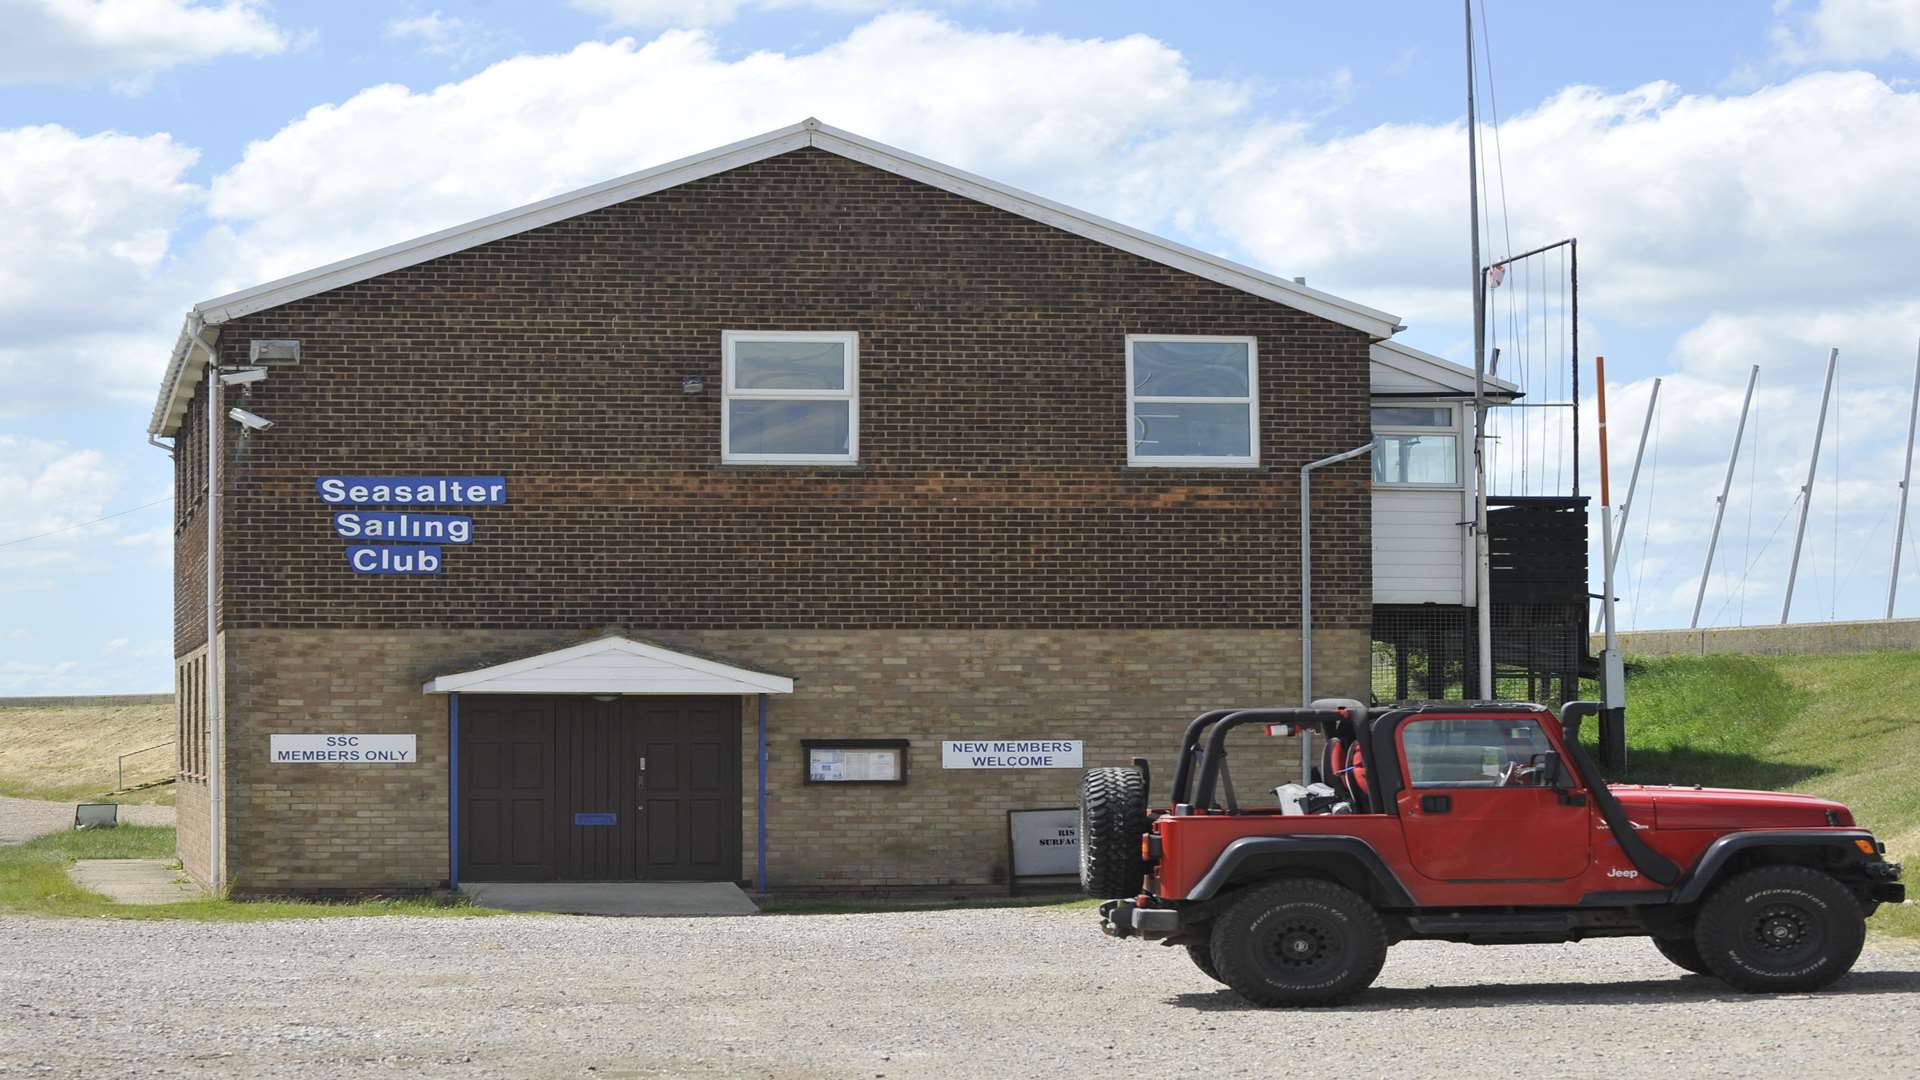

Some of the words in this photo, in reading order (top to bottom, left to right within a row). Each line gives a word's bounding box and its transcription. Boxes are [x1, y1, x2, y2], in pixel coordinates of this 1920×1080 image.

[321, 479, 503, 502] Seasalter
[337, 514, 469, 542] Sailing
[353, 549, 438, 571] Club
[326, 736, 359, 747] SSC
[952, 743, 988, 753] NEW
[993, 742, 1073, 753] MEMBERS
[278, 750, 360, 761] MEMBERS
[365, 750, 408, 761] ONLY
[972, 756, 1053, 767] WELCOME
[1607, 868, 1638, 879] Jeep
